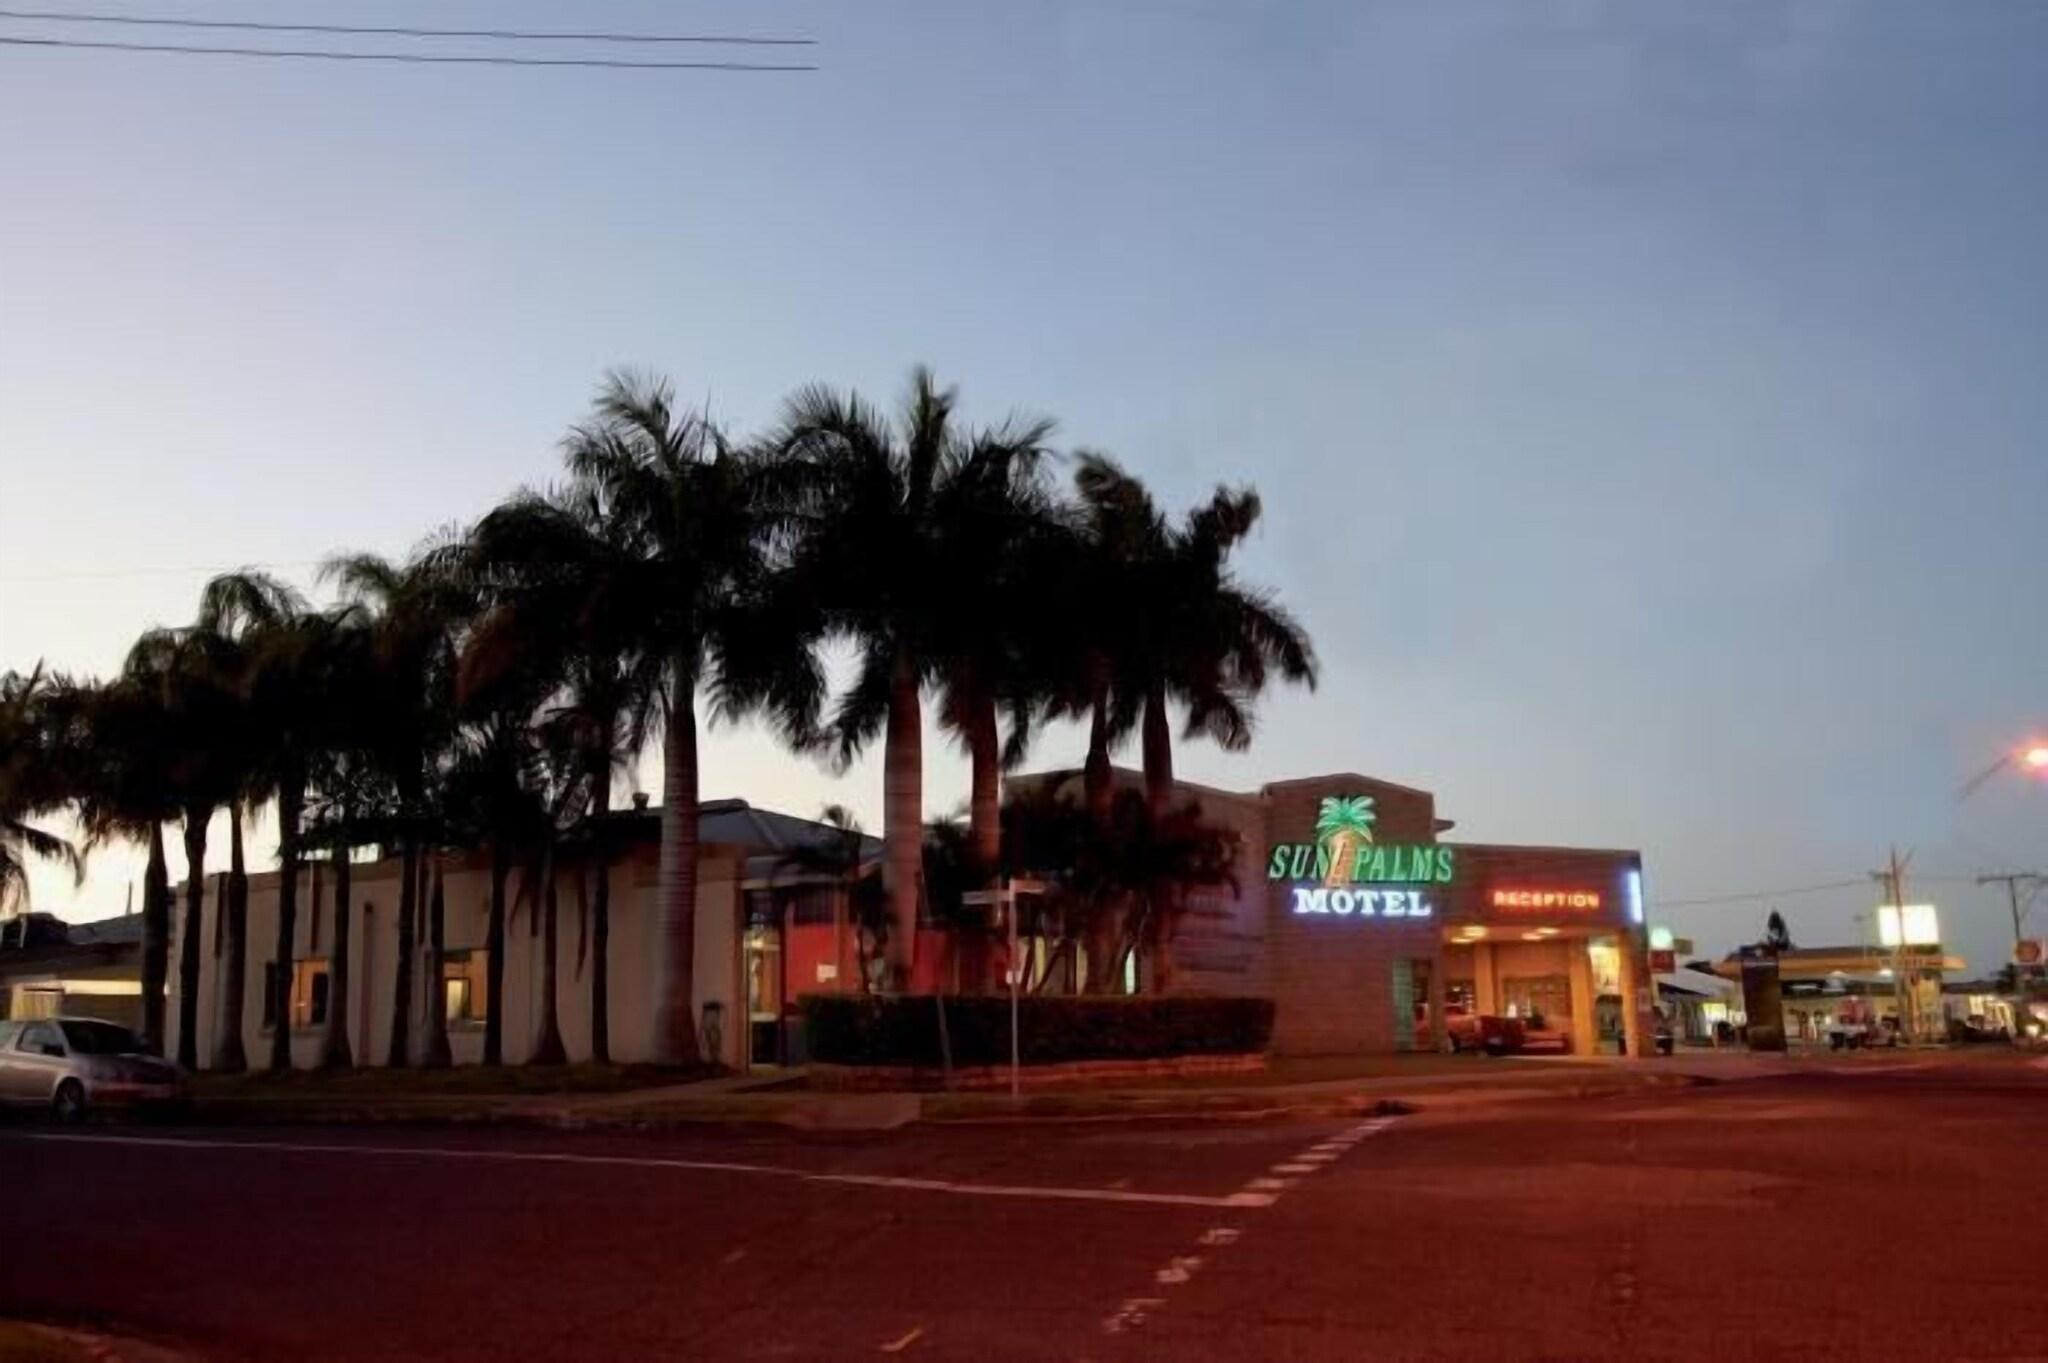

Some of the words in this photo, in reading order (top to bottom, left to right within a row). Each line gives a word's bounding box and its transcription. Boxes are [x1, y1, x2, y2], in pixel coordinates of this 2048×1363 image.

[1269, 844, 1334, 880] SUN
[1354, 845, 1453, 882] PALMS
[1292, 888, 1432, 917] MOTEL
[1493, 891, 1600, 909] RECEPTION
